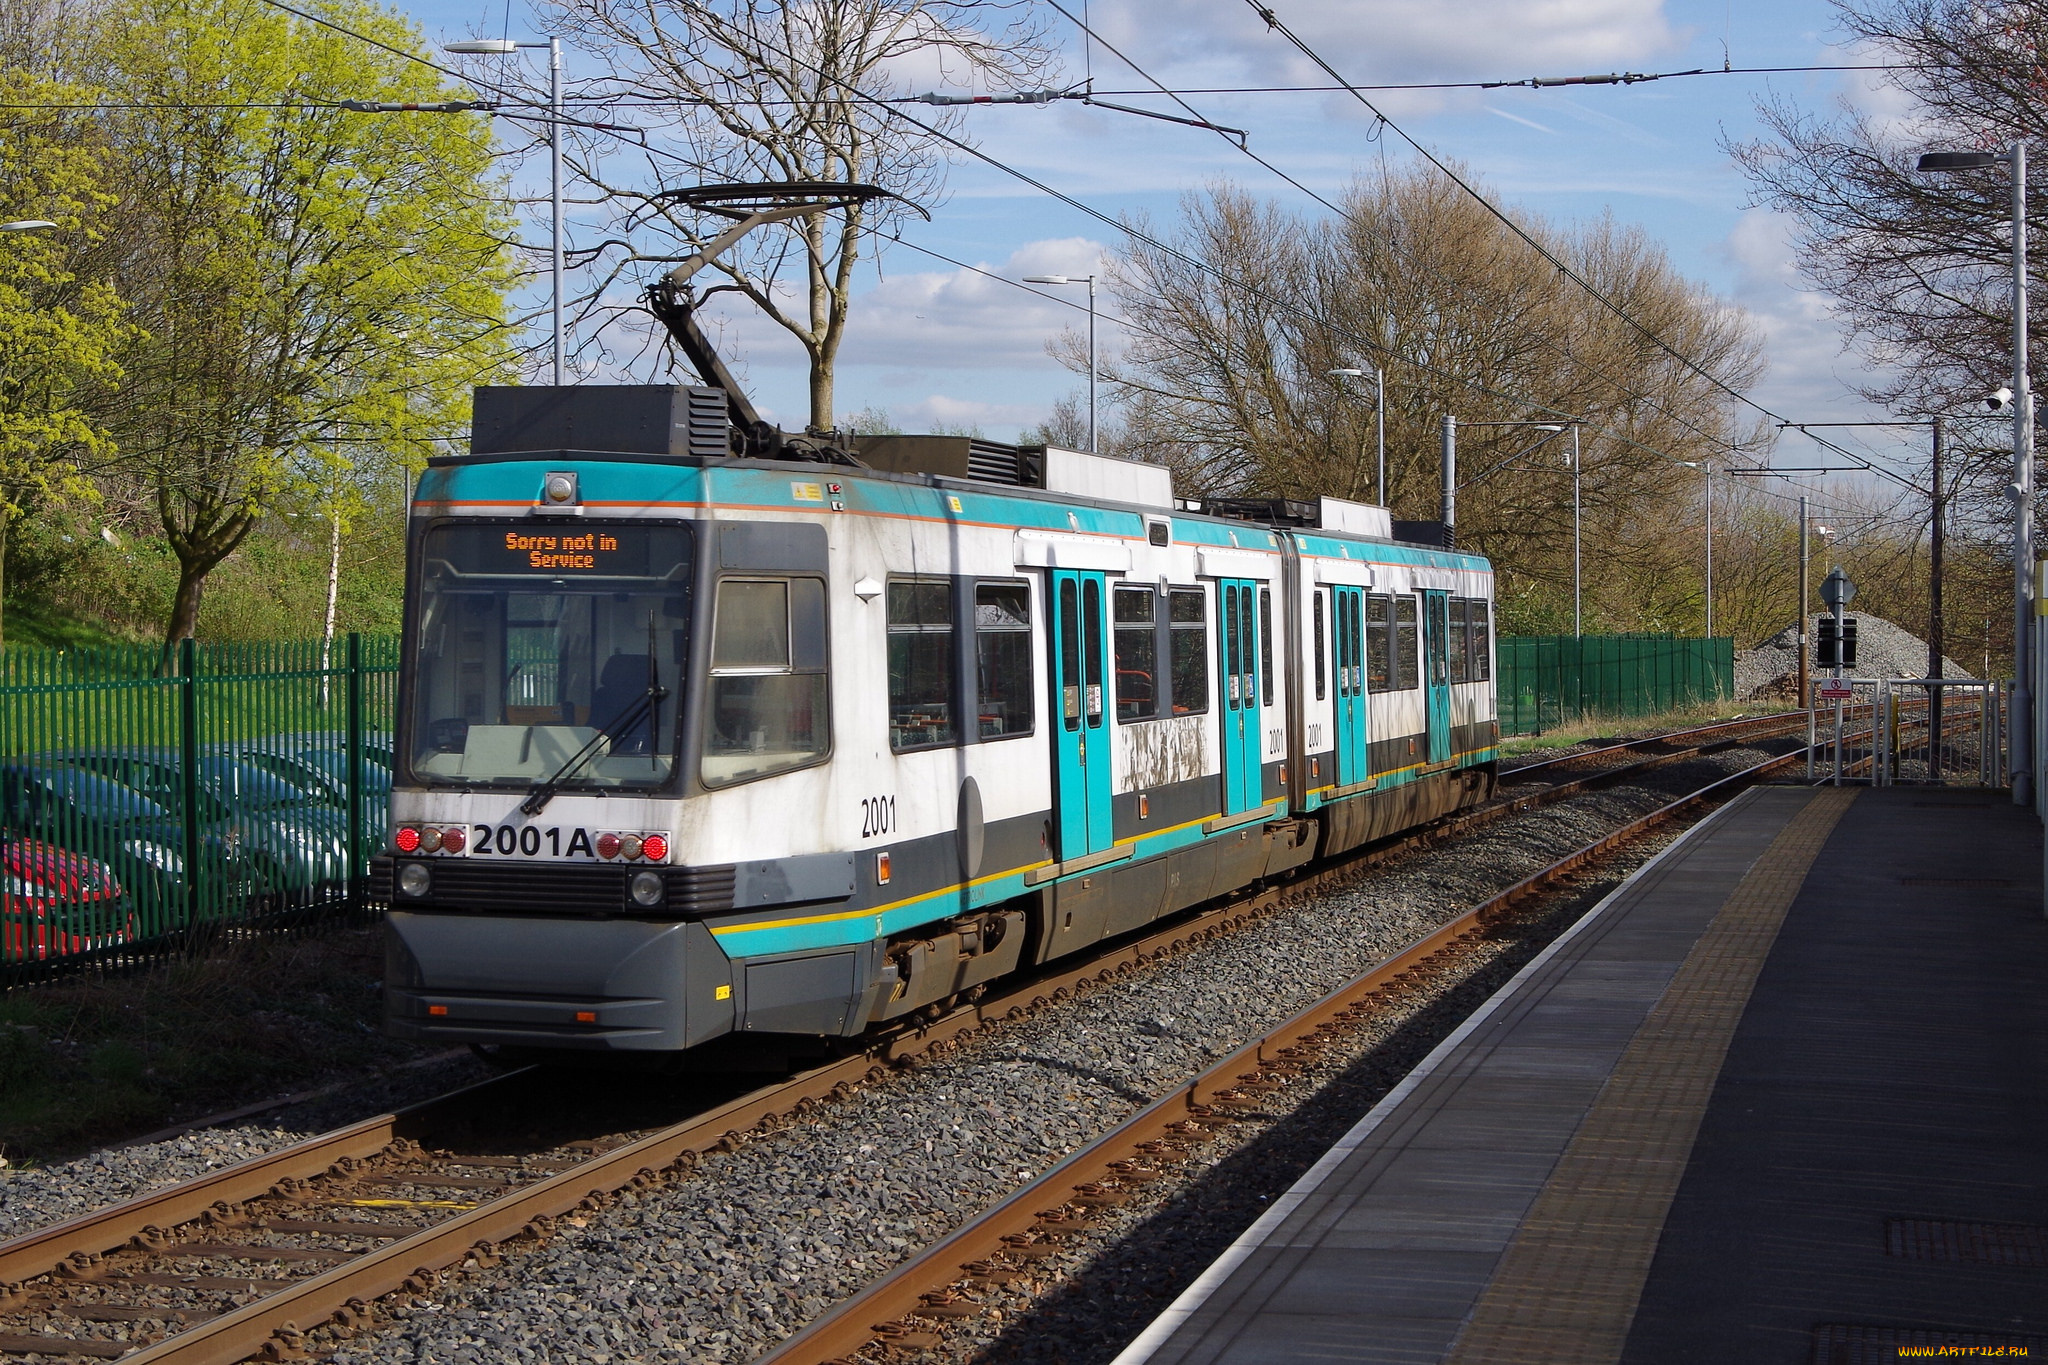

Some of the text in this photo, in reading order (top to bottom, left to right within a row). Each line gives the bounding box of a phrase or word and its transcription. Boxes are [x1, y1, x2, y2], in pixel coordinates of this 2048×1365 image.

[505, 532, 617, 550] Sorry not in
[529, 550, 594, 568] Service
[1269, 728, 1284, 755] 2001
[1309, 723, 1322, 748] 2001
[861, 794, 896, 839] 2001
[472, 824, 595, 858] 2001A
